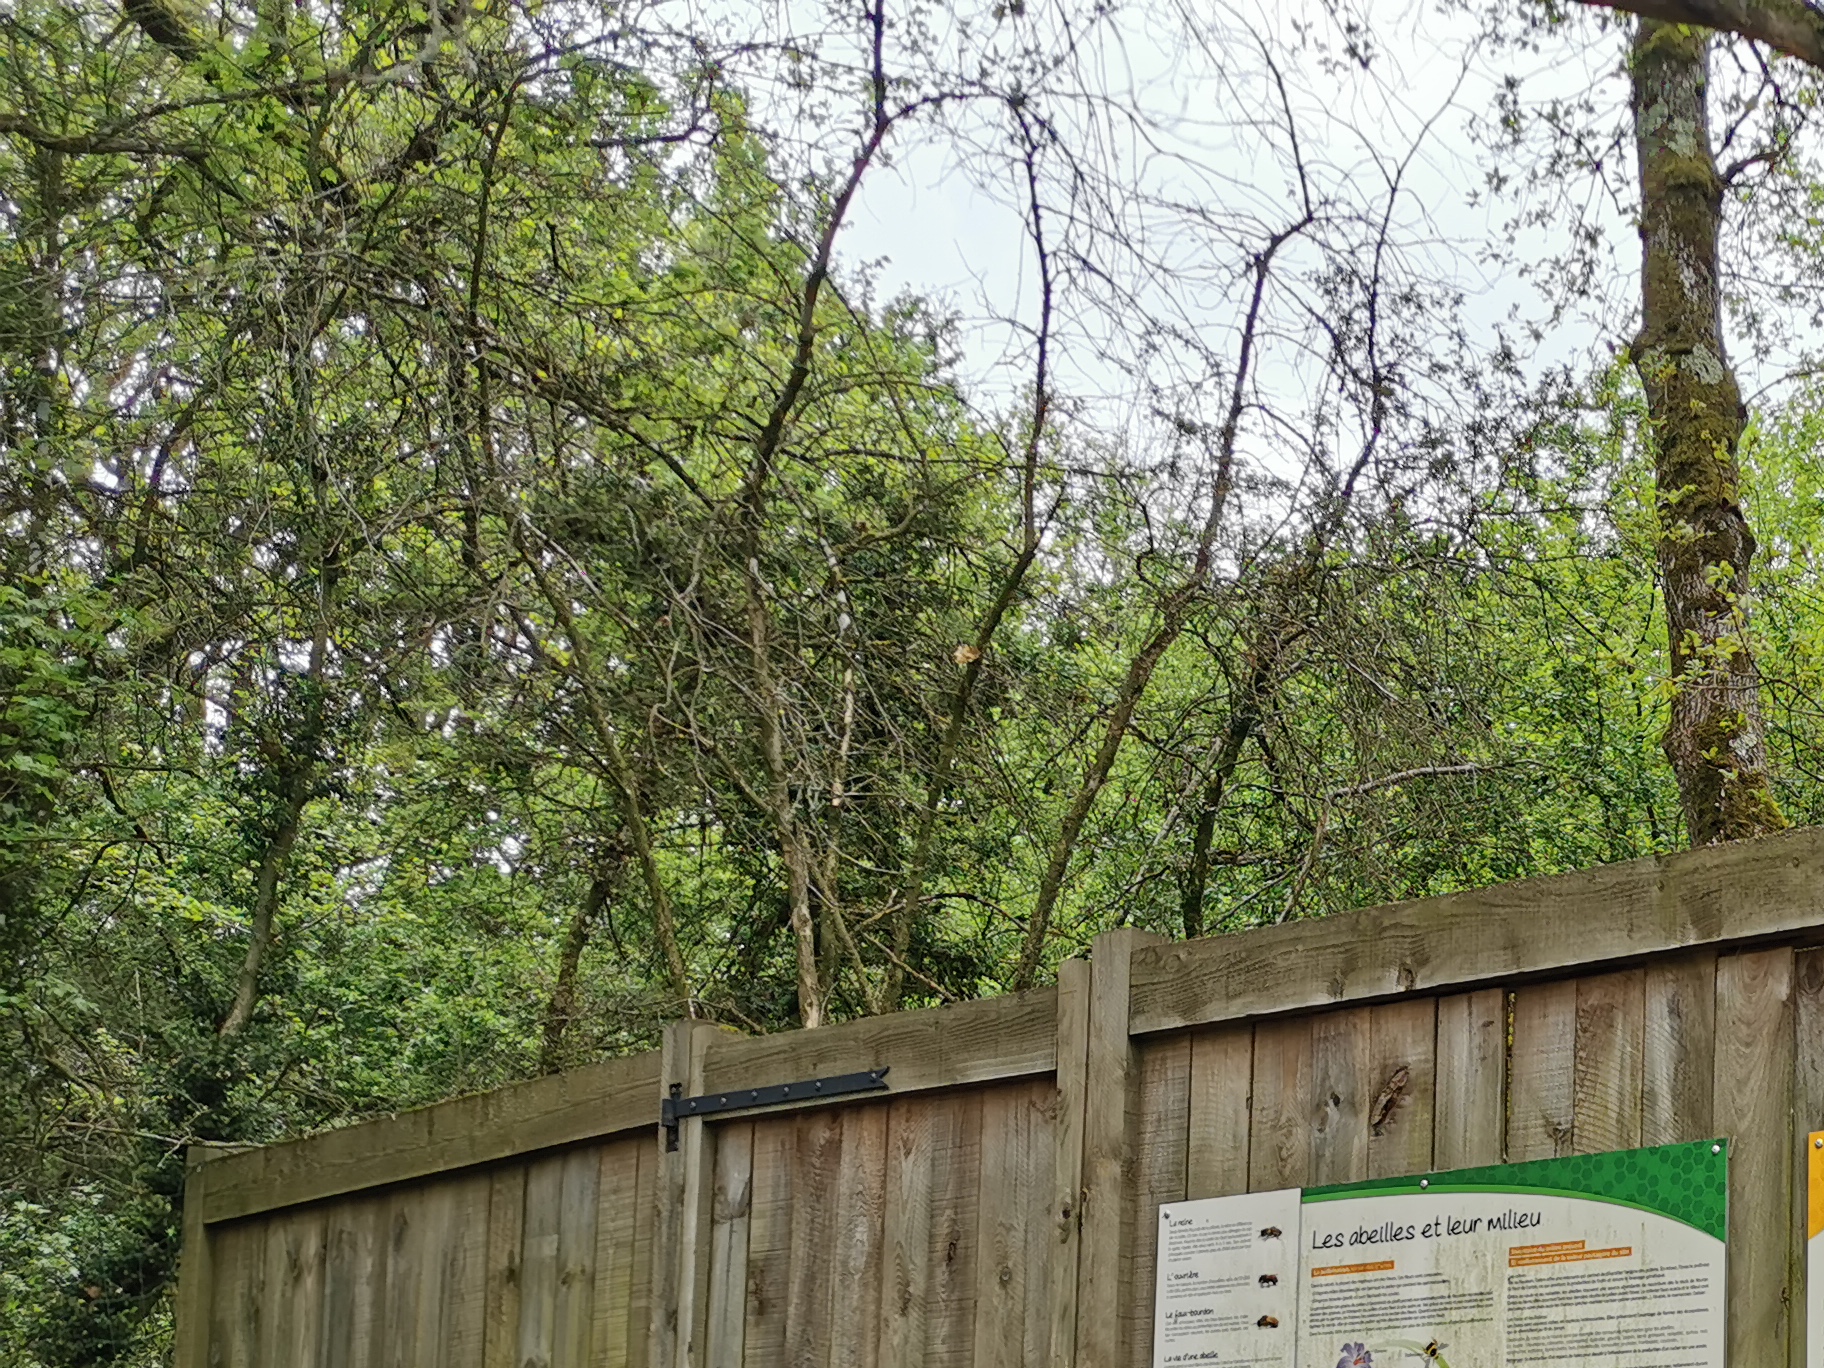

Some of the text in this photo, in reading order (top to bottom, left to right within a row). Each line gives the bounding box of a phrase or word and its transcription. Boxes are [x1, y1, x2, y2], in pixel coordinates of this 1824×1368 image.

[1313, 1209, 1541, 1249] Les abeilles et leur milieu
